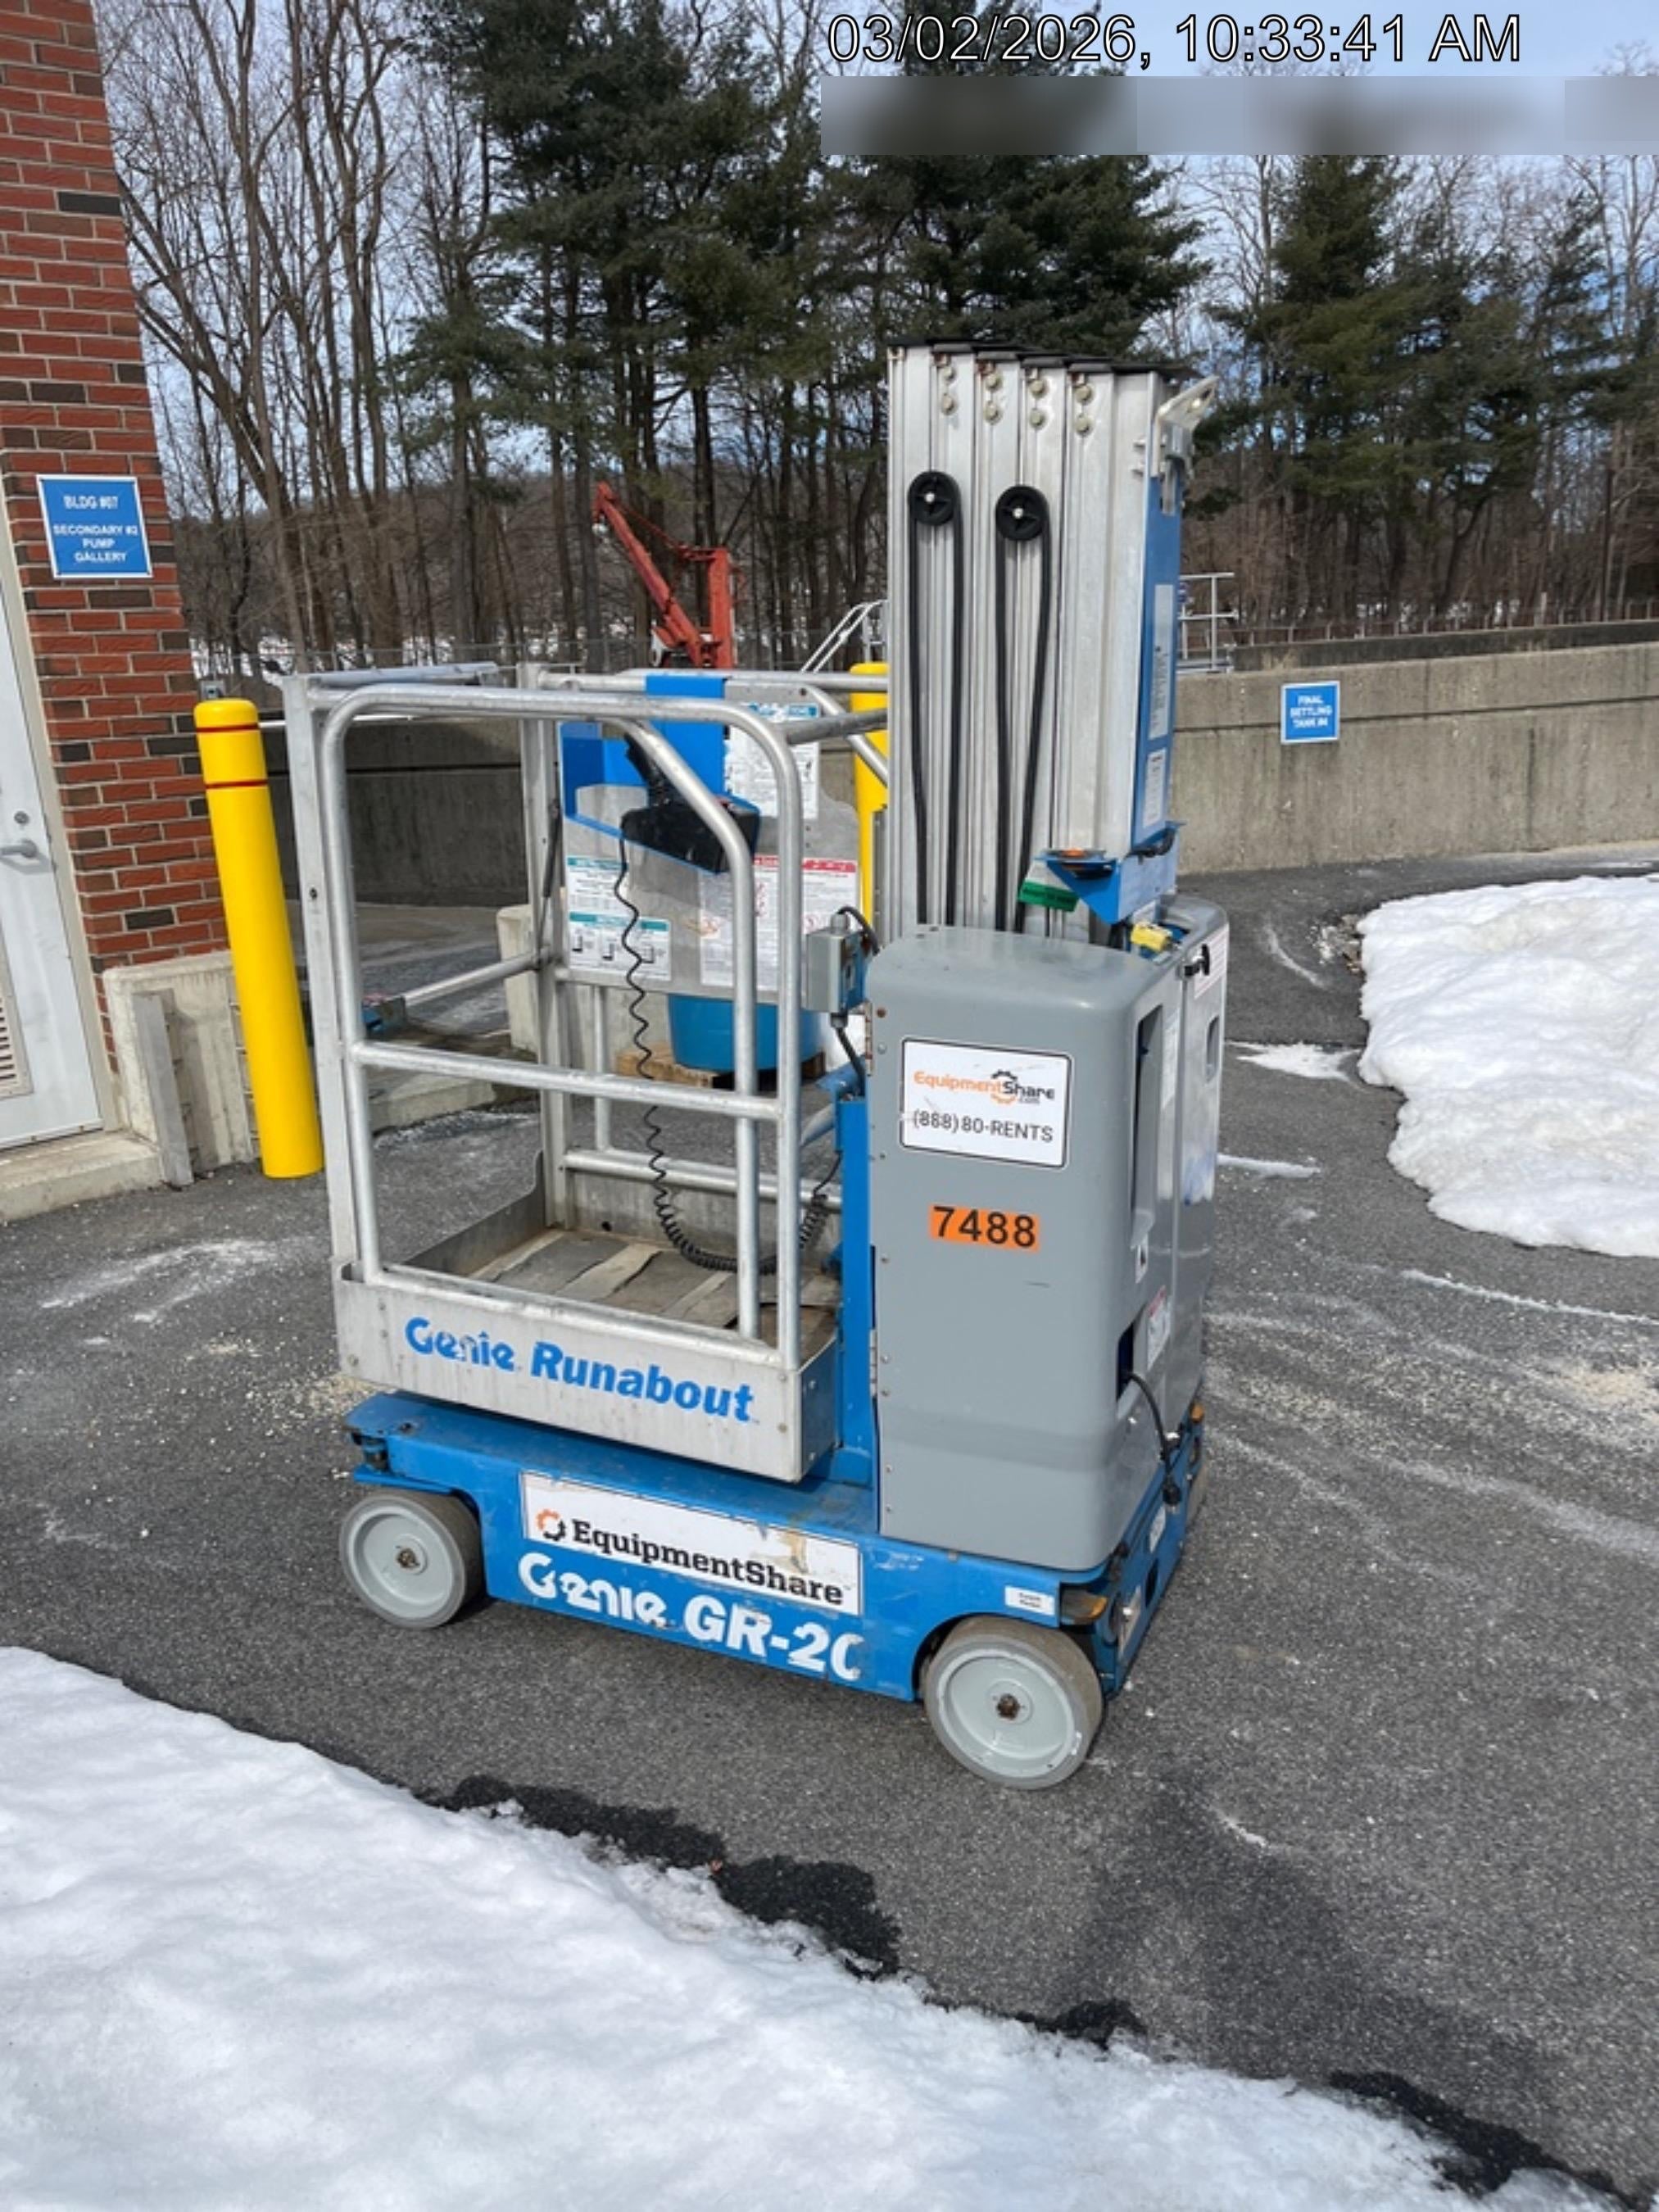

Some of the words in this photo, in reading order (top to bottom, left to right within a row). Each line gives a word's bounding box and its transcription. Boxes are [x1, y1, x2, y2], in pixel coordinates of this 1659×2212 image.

[63, 496, 97, 510] BLDG
[53, 524, 123, 536] SECONDARY
[82, 537, 116, 549] PUMP
[75, 551, 128, 564] GALLERY
[933, 1205, 1036, 1248] 7488
[405, 1317, 515, 1372] Genie
[530, 1341, 754, 1421] Runabout
[572, 1518, 845, 1607] EquipmentShare
